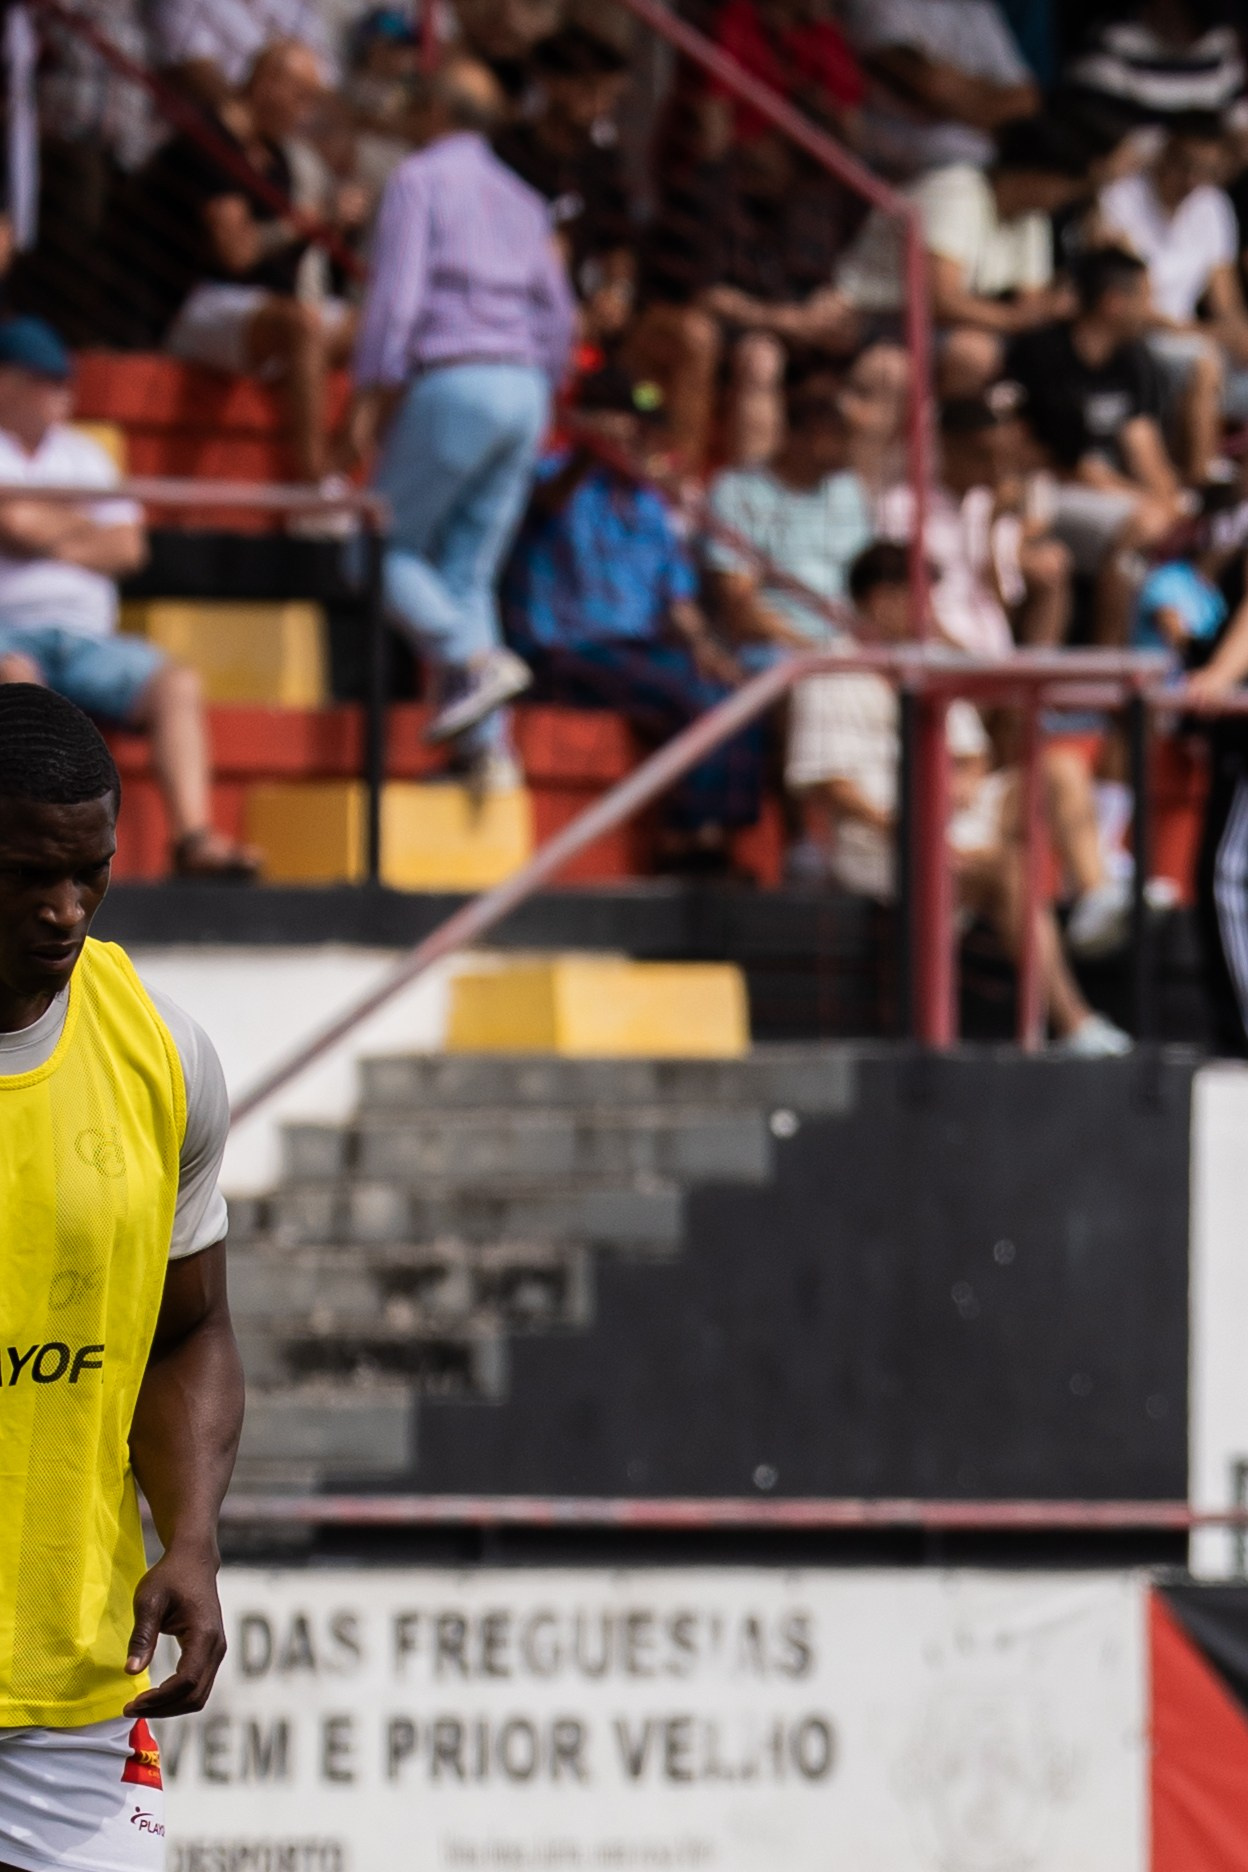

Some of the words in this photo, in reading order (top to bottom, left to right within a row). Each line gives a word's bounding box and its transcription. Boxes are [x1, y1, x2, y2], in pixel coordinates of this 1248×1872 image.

[0, 1341, 105, 1388] YOF
[237, 1608, 363, 1678] DAS
[321, 1715, 357, 1785] E
[385, 1714, 592, 1786] PRIOR
